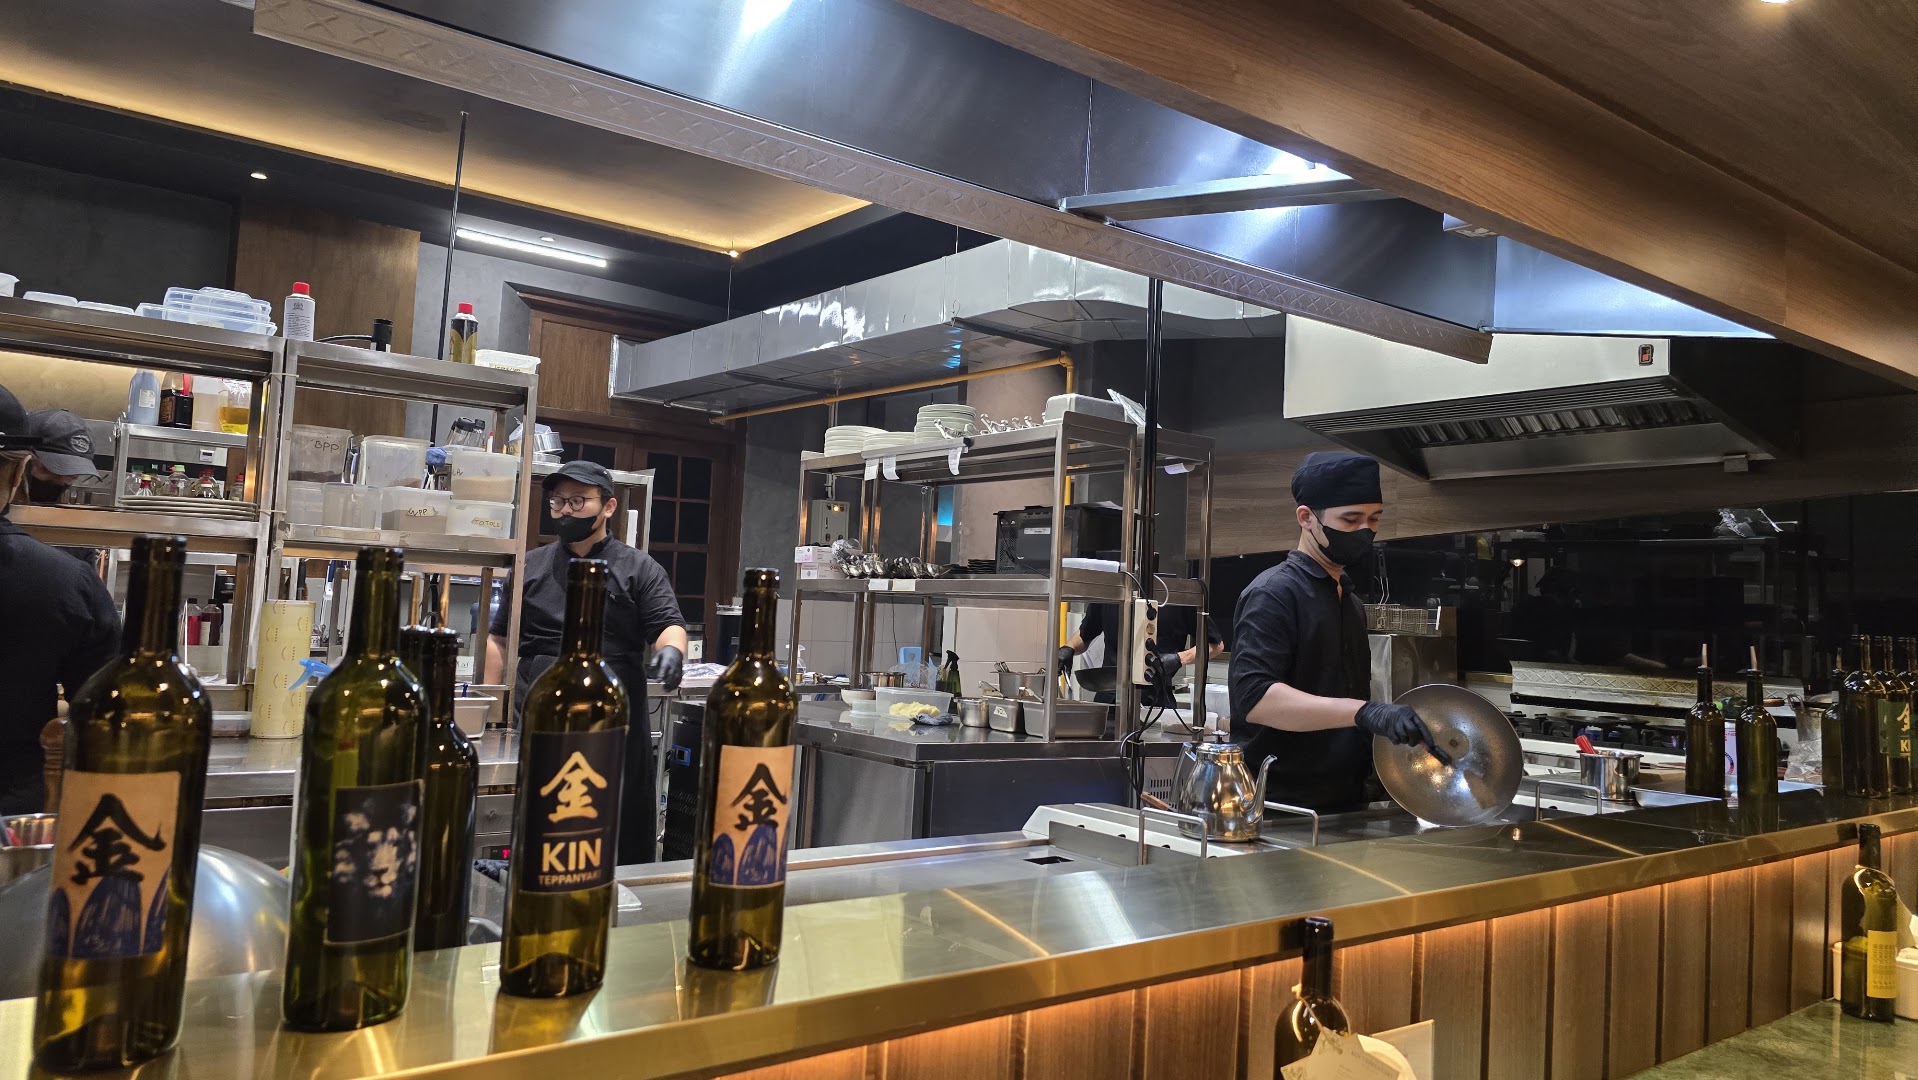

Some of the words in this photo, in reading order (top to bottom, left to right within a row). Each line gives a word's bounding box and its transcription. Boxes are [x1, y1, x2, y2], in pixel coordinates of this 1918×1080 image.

[315, 441, 339, 453] BPP
[540, 751, 608, 824] 金
[730, 763, 787, 831] 金
[68, 792, 167, 885] 金
[542, 838, 602, 873] KIN
